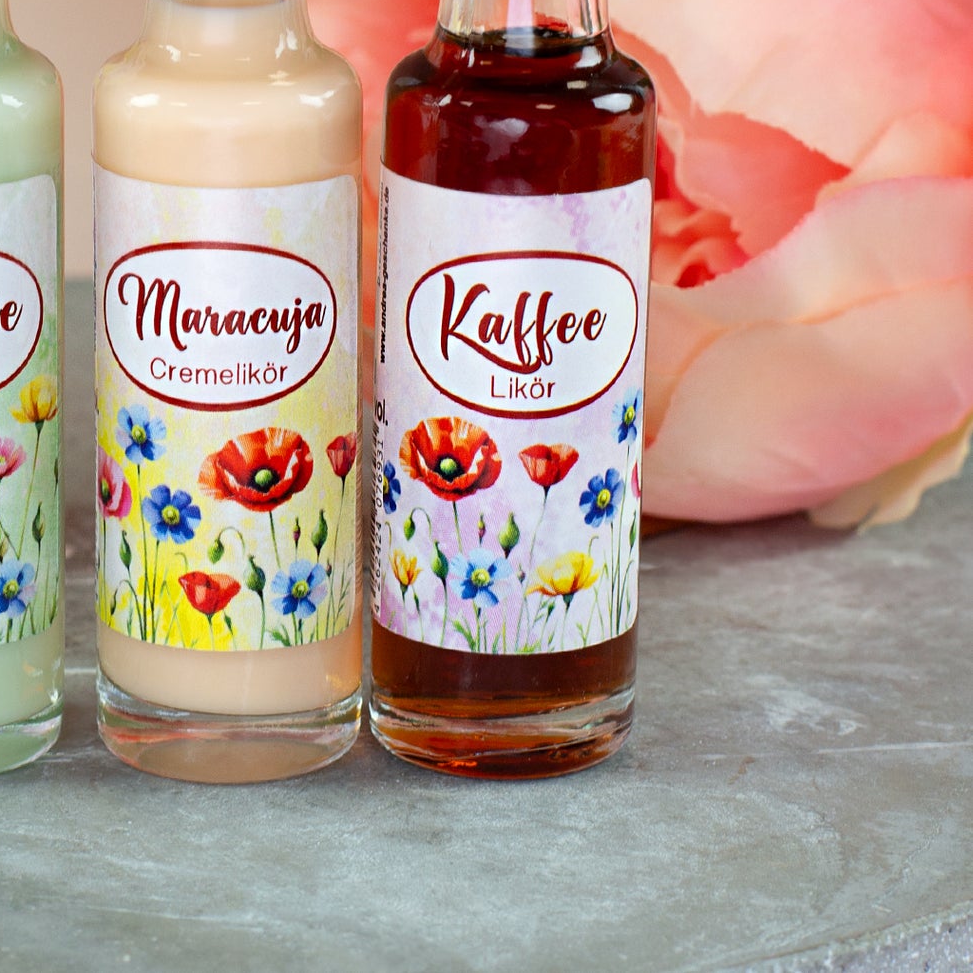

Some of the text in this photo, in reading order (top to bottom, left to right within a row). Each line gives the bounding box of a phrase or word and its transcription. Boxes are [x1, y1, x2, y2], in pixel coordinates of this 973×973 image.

[118, 273, 326, 354] Maracuja
[380, 186, 390, 364] www.andrea-geschenke.de
[440, 273, 607, 374] Kaffee
[150, 357, 287, 385] Cremelikör
[491, 375, 555, 399] Likör
